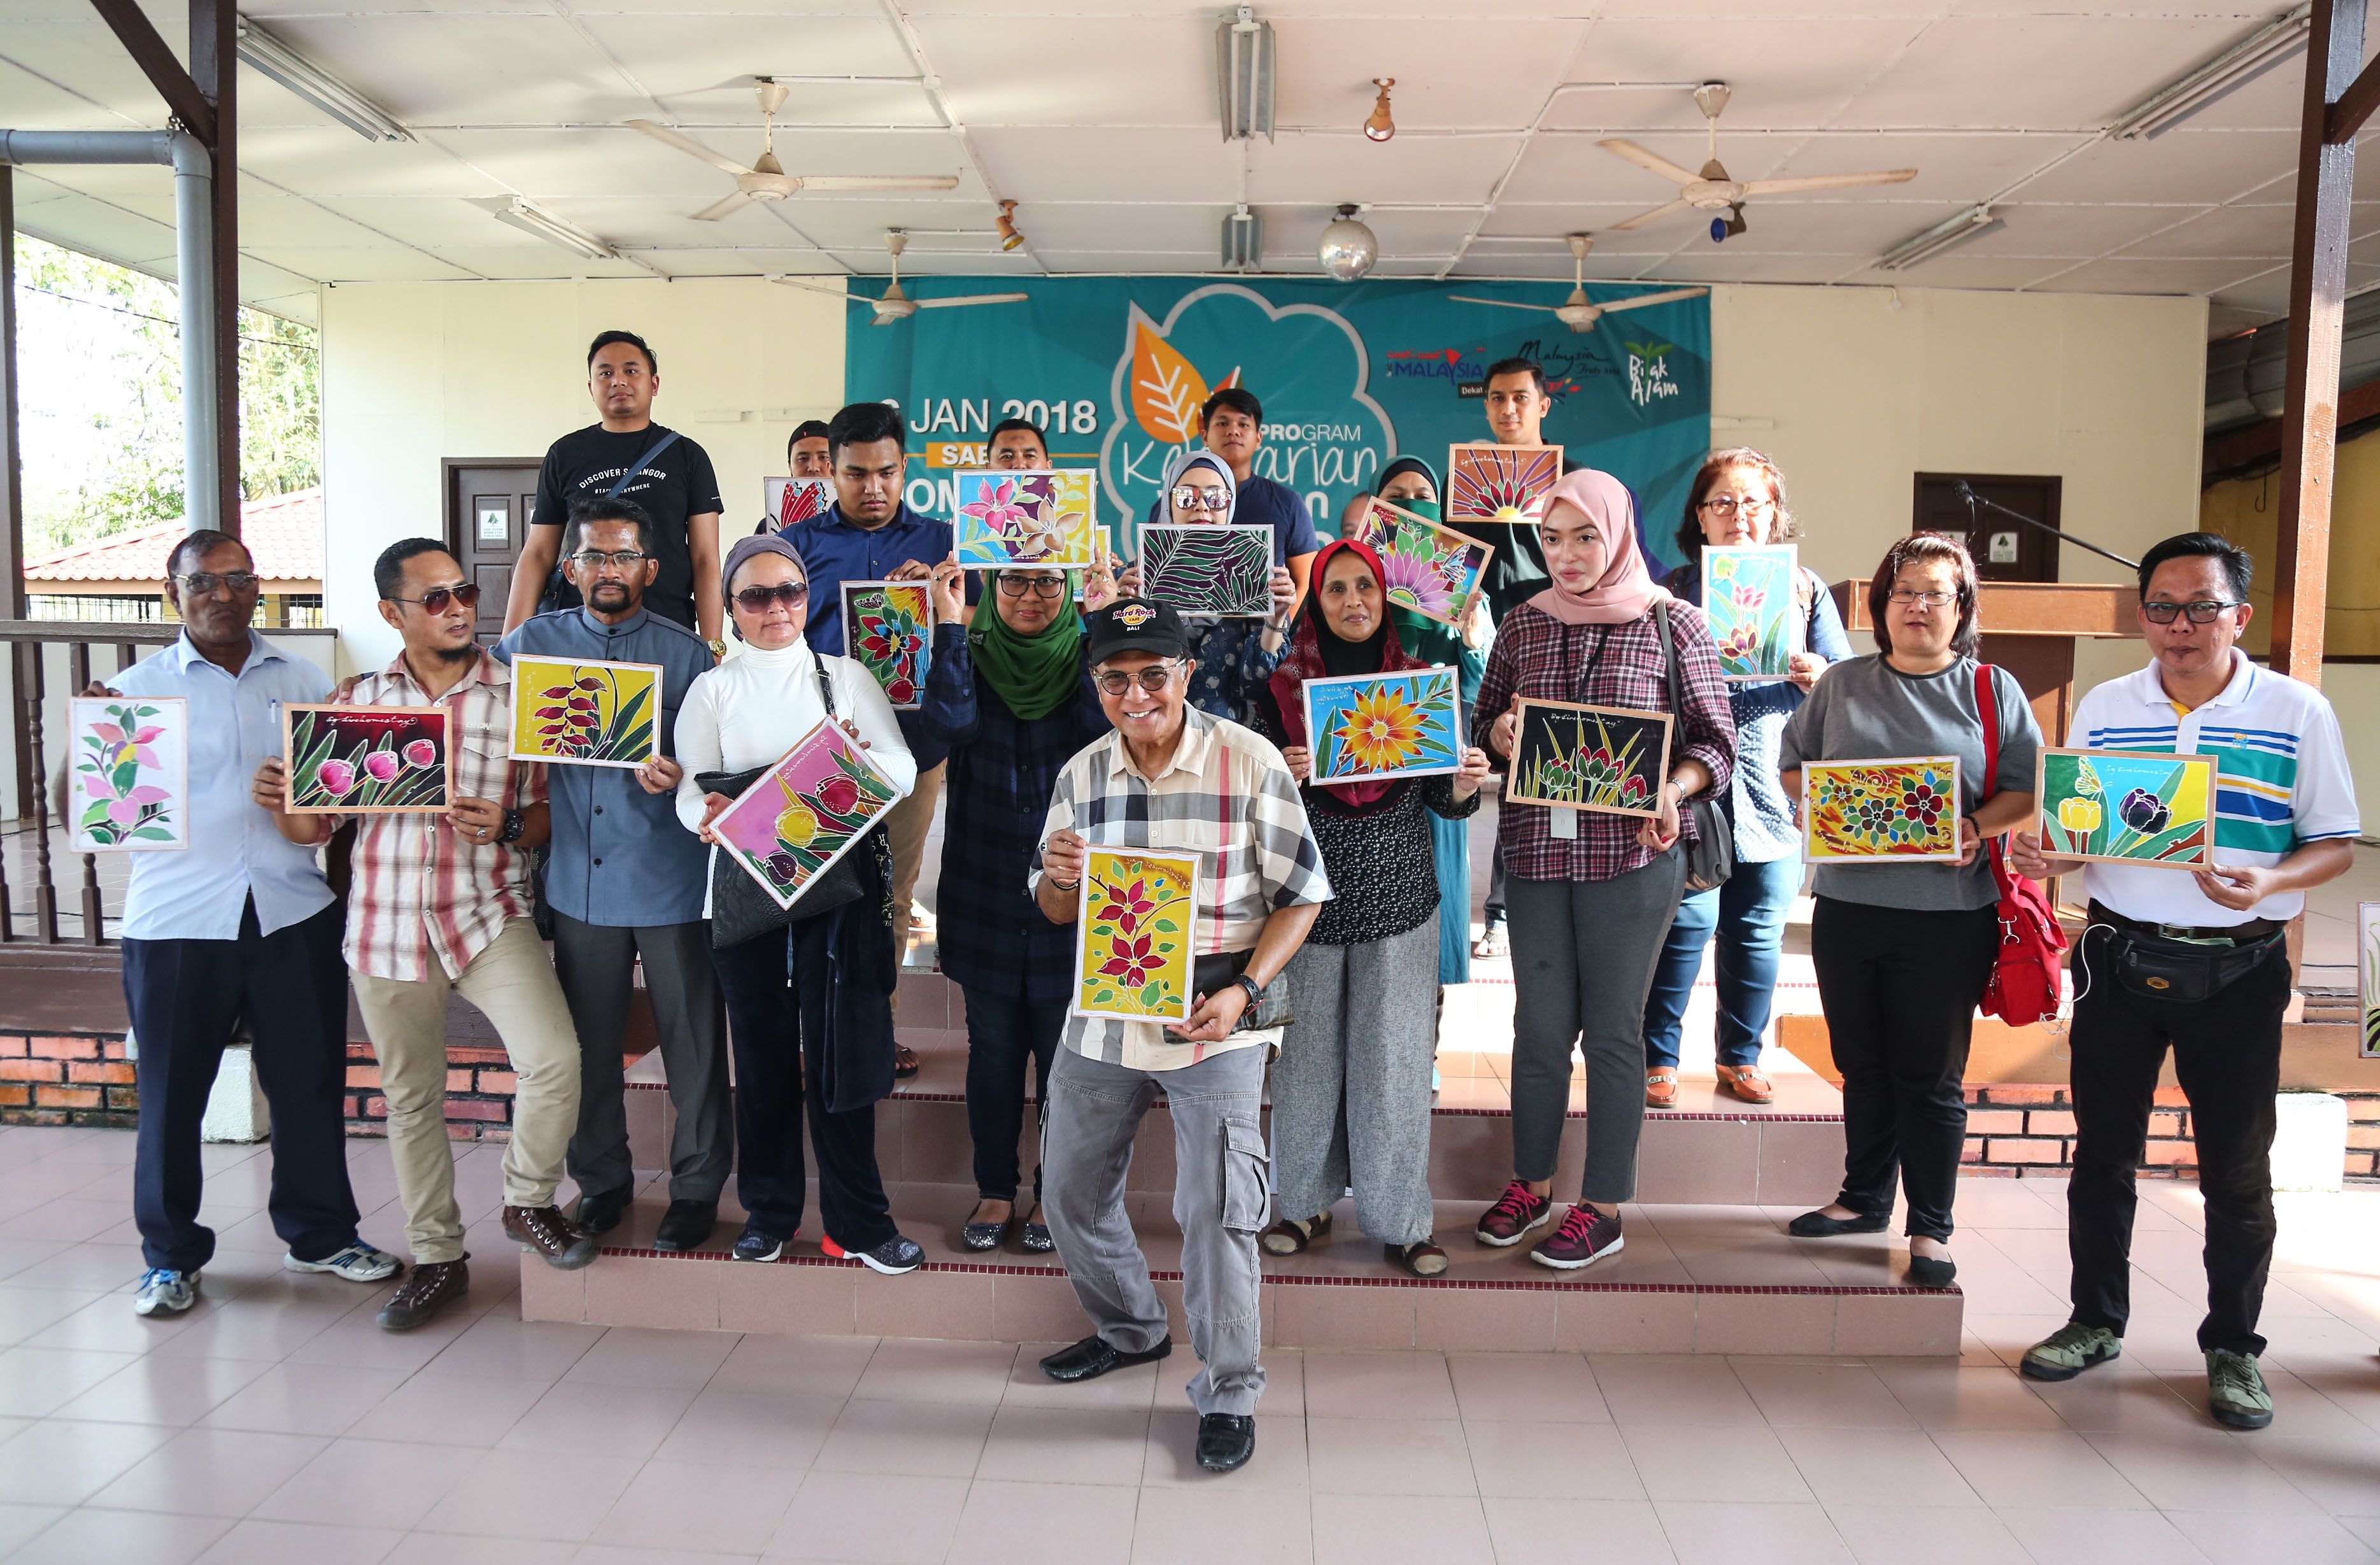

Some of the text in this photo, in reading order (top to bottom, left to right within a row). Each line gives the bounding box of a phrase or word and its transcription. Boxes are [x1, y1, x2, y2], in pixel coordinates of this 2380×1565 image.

[1394, 360, 1485, 386] MALAYSIA
[910, 399, 1097, 434] JAN 2018
[1259, 423, 1361, 441] PROGRAM
[579, 468, 666, 489] DISCOVER SANGOR
[1112, 608, 1156, 620] Hard Rock
